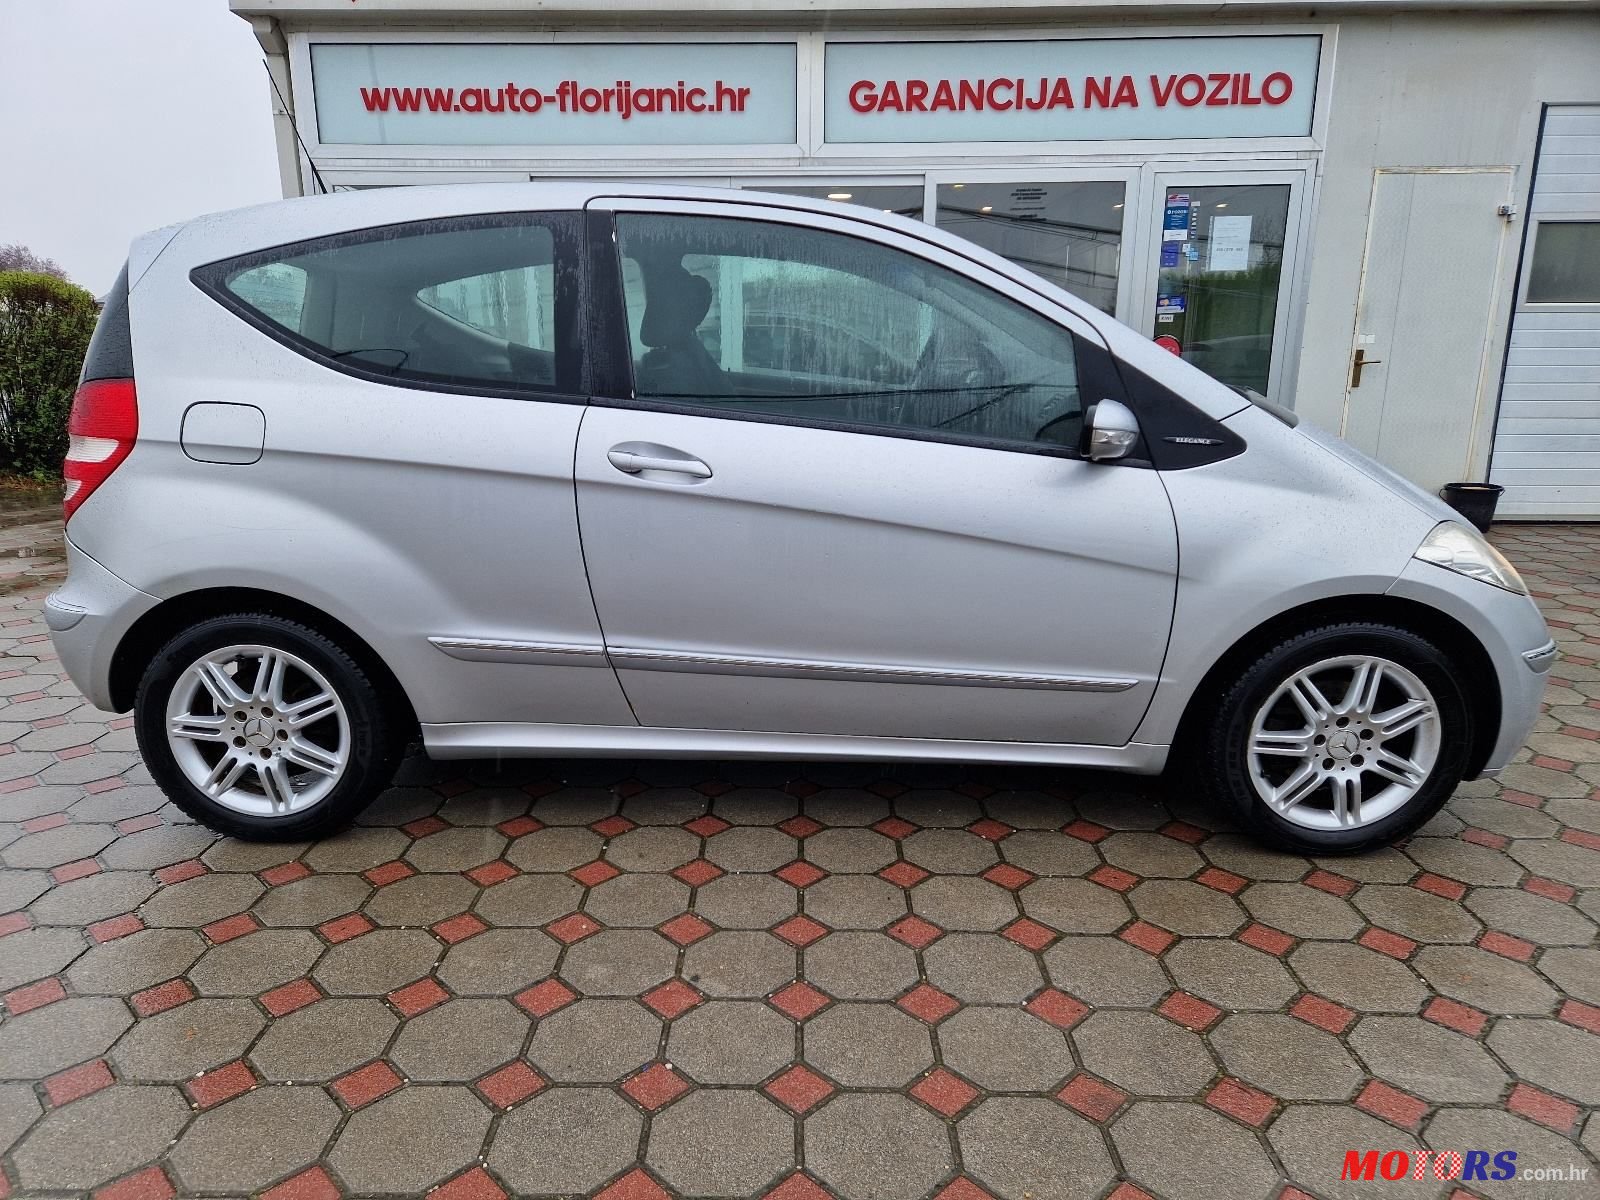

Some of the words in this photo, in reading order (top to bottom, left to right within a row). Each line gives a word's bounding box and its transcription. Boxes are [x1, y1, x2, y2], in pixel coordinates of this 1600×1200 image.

[360, 80, 751, 120] www.auto-florijanic.hr
[848, 77, 1075, 113] GARANCIJA
[1084, 75, 1139, 108] NA
[1150, 71, 1294, 107] VOZILO
[1175, 436, 1212, 445] ELEGANCE
